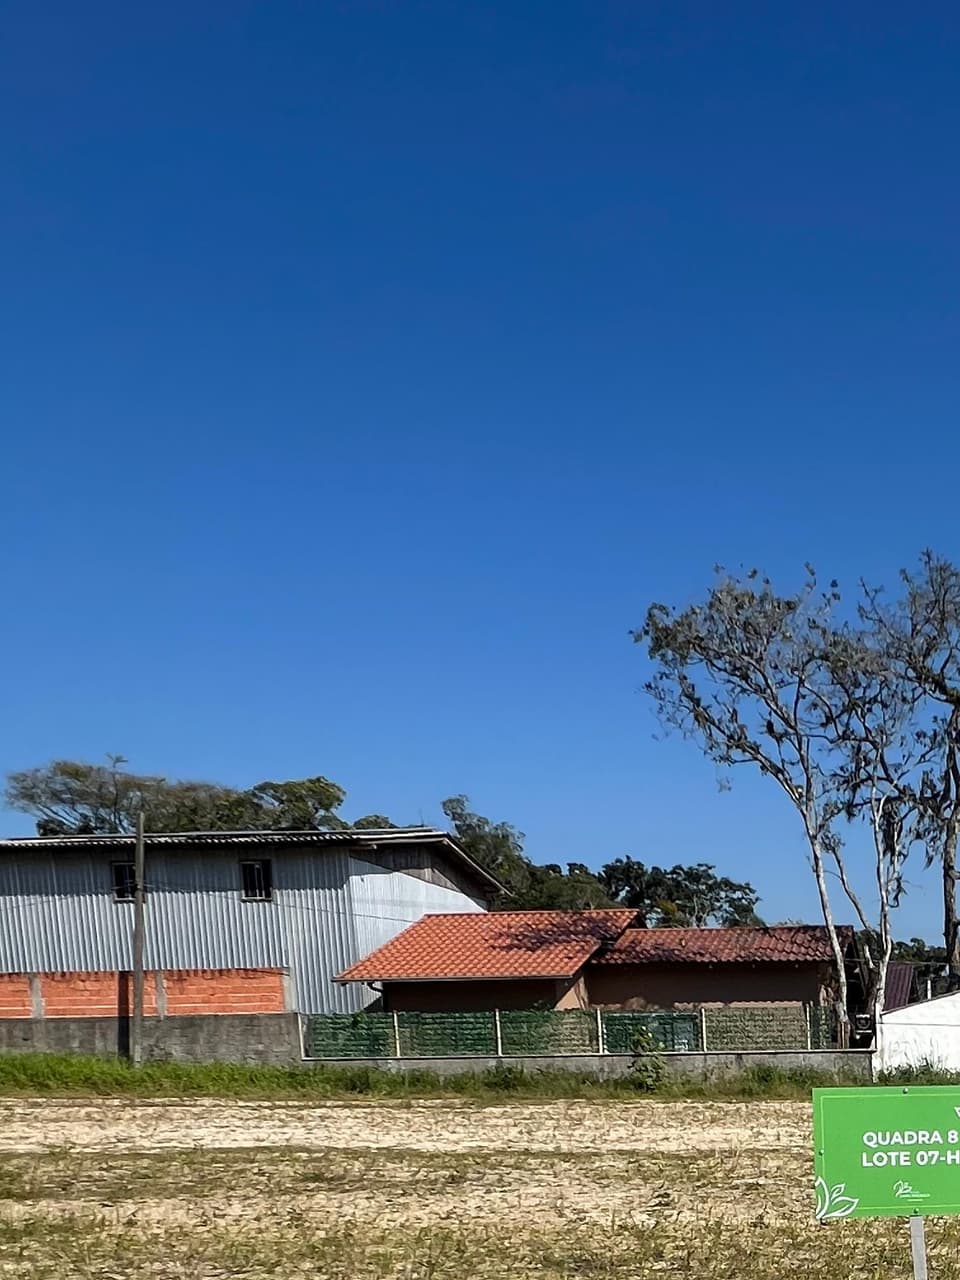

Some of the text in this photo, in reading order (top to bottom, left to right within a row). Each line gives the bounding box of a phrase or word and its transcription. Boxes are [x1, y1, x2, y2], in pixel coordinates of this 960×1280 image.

[862, 1130, 959, 1147] QUADRA 8
[862, 1150, 960, 1167] LOTE 07-H
